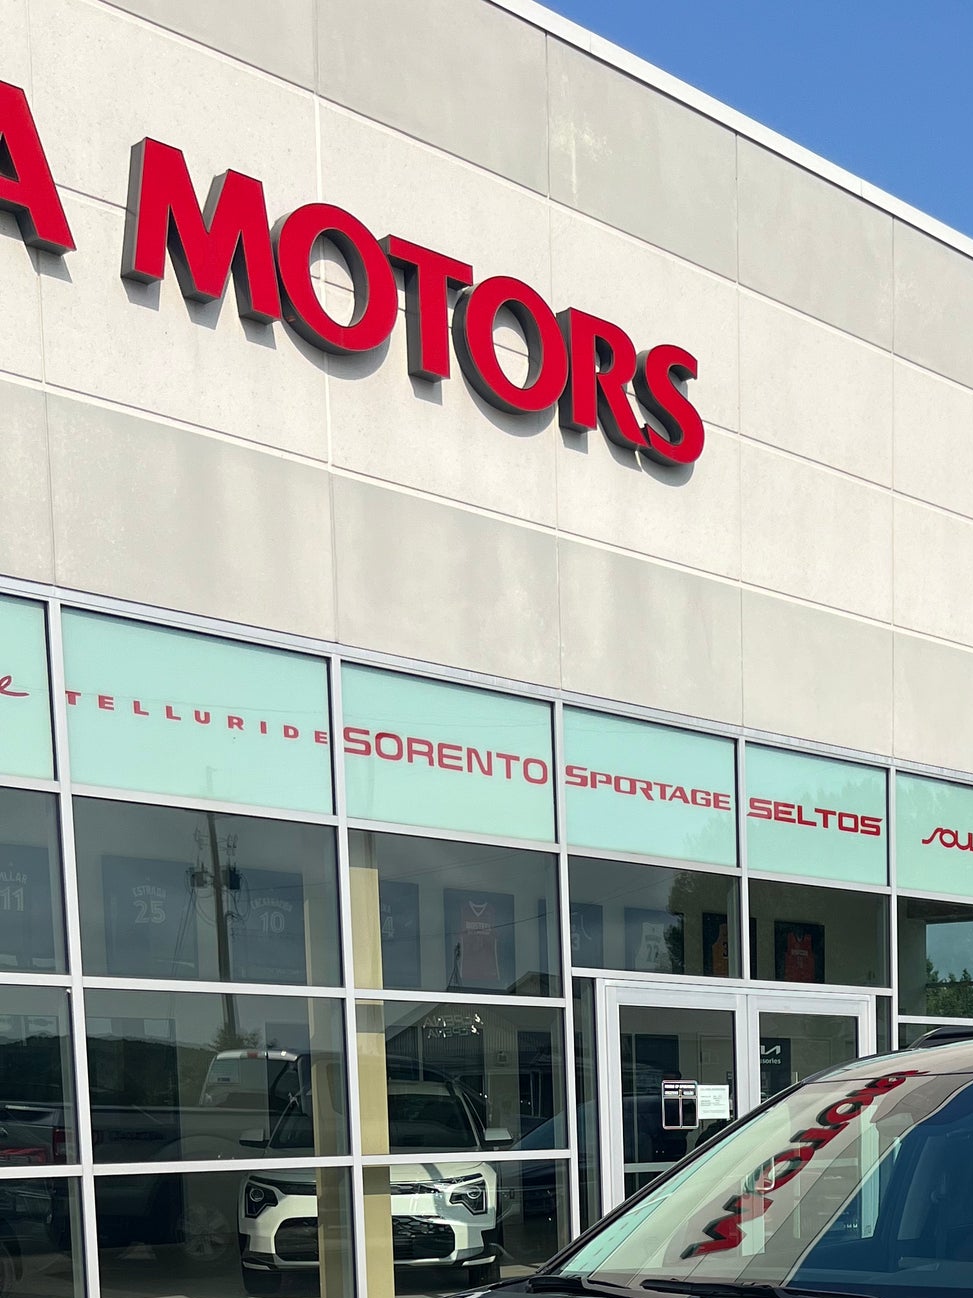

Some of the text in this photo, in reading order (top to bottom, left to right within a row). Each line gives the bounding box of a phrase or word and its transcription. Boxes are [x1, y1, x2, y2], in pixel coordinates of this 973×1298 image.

[123, 137, 706, 466] MOTORS
[66, 691, 328, 744] TELLURIDE
[343, 726, 549, 785] SORENTO
[565, 765, 731, 811] SPORTAGE
[747, 797, 883, 837] SELTOS
[133, 900, 166, 924] 25
[259, 911, 285, 934] 10
